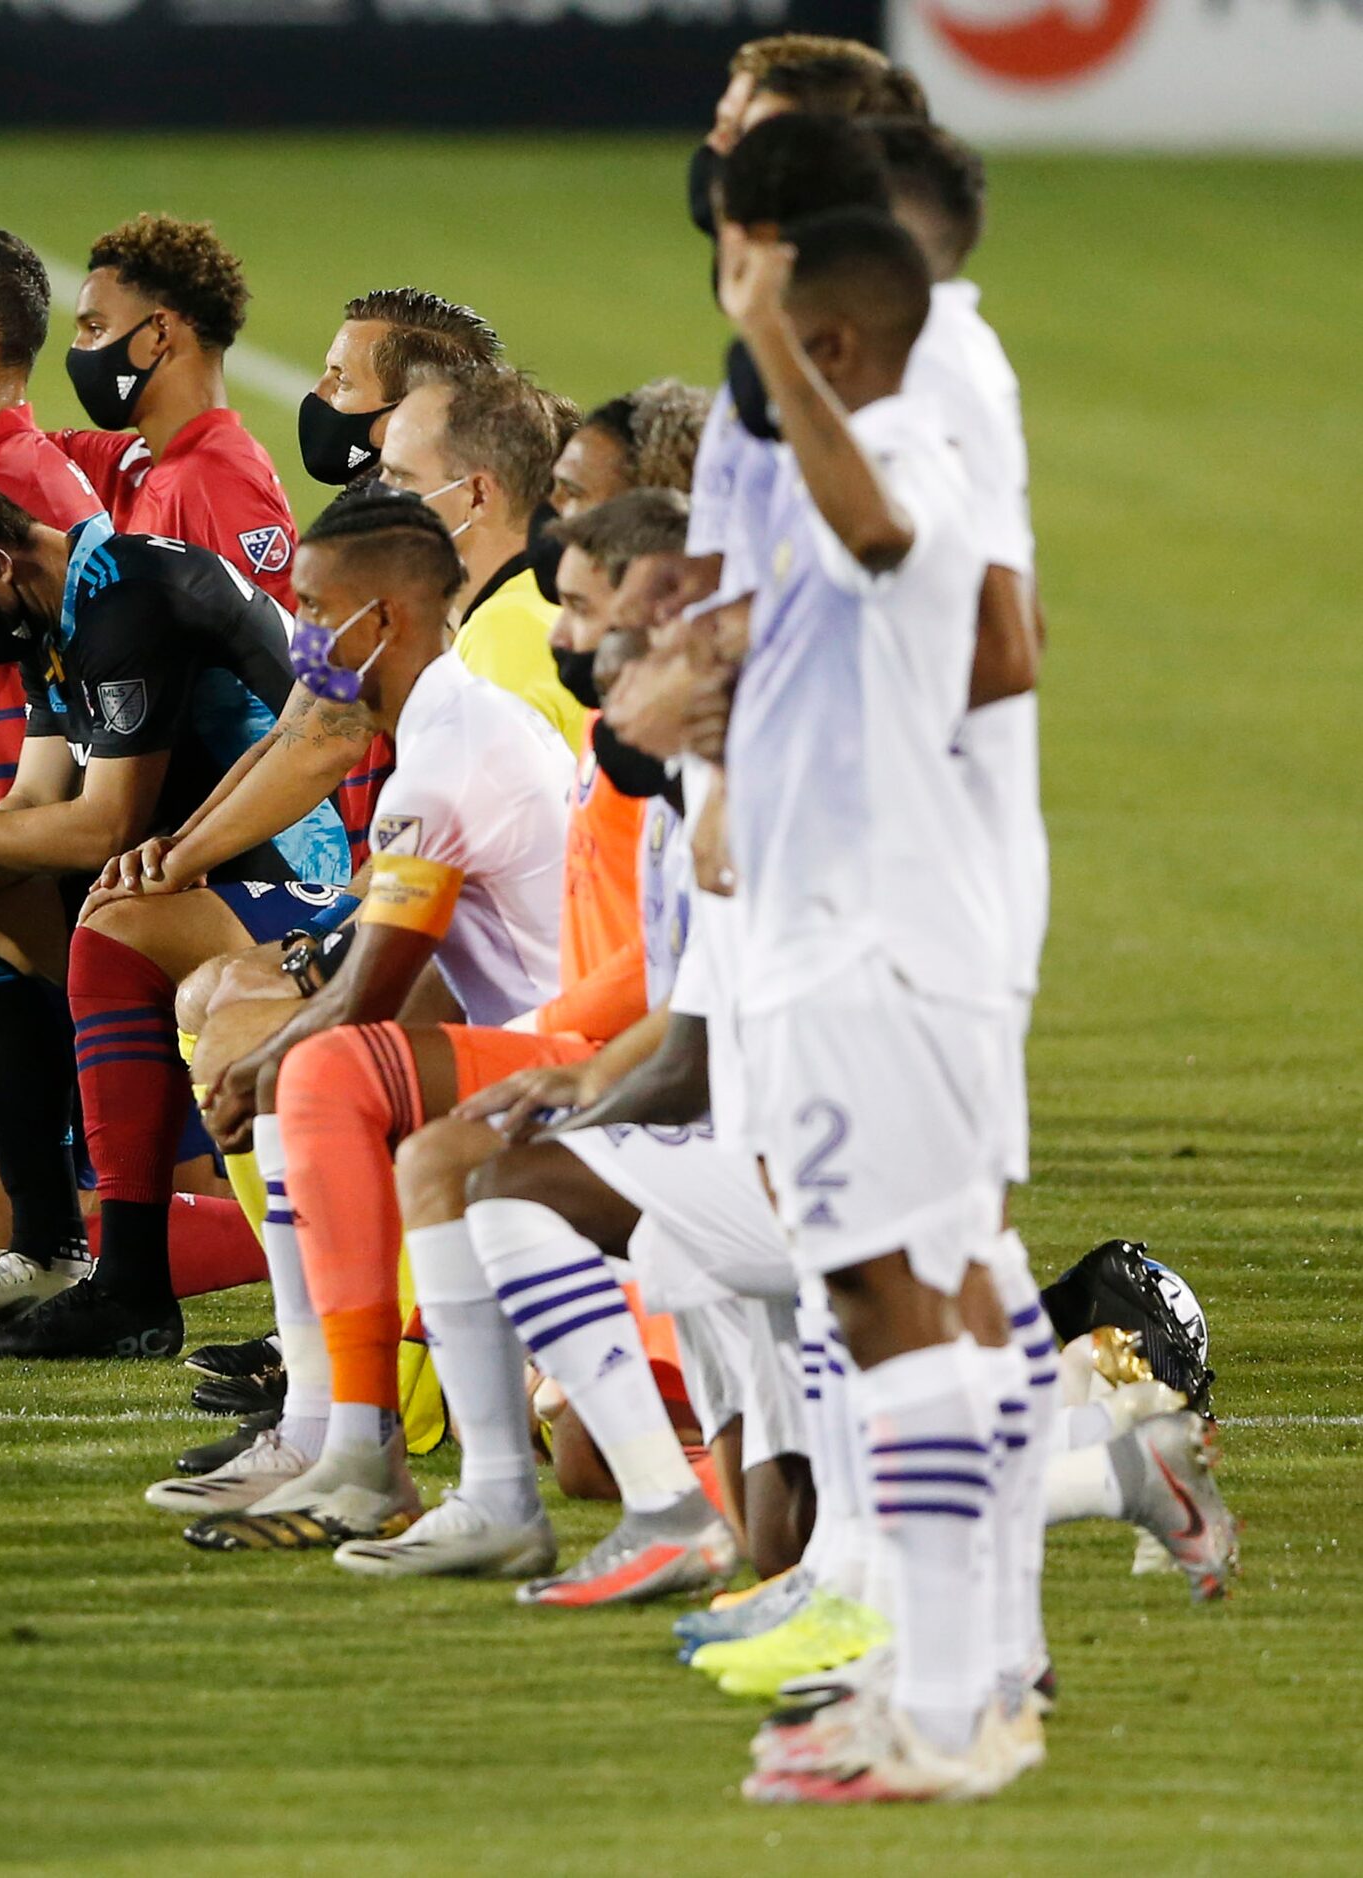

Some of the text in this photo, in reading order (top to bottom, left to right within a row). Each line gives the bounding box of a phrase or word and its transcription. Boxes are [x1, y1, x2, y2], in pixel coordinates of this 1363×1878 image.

[244, 532, 269, 546] MLS
[102, 687, 126, 698] MLS
[795, 1095, 849, 1189] 2
